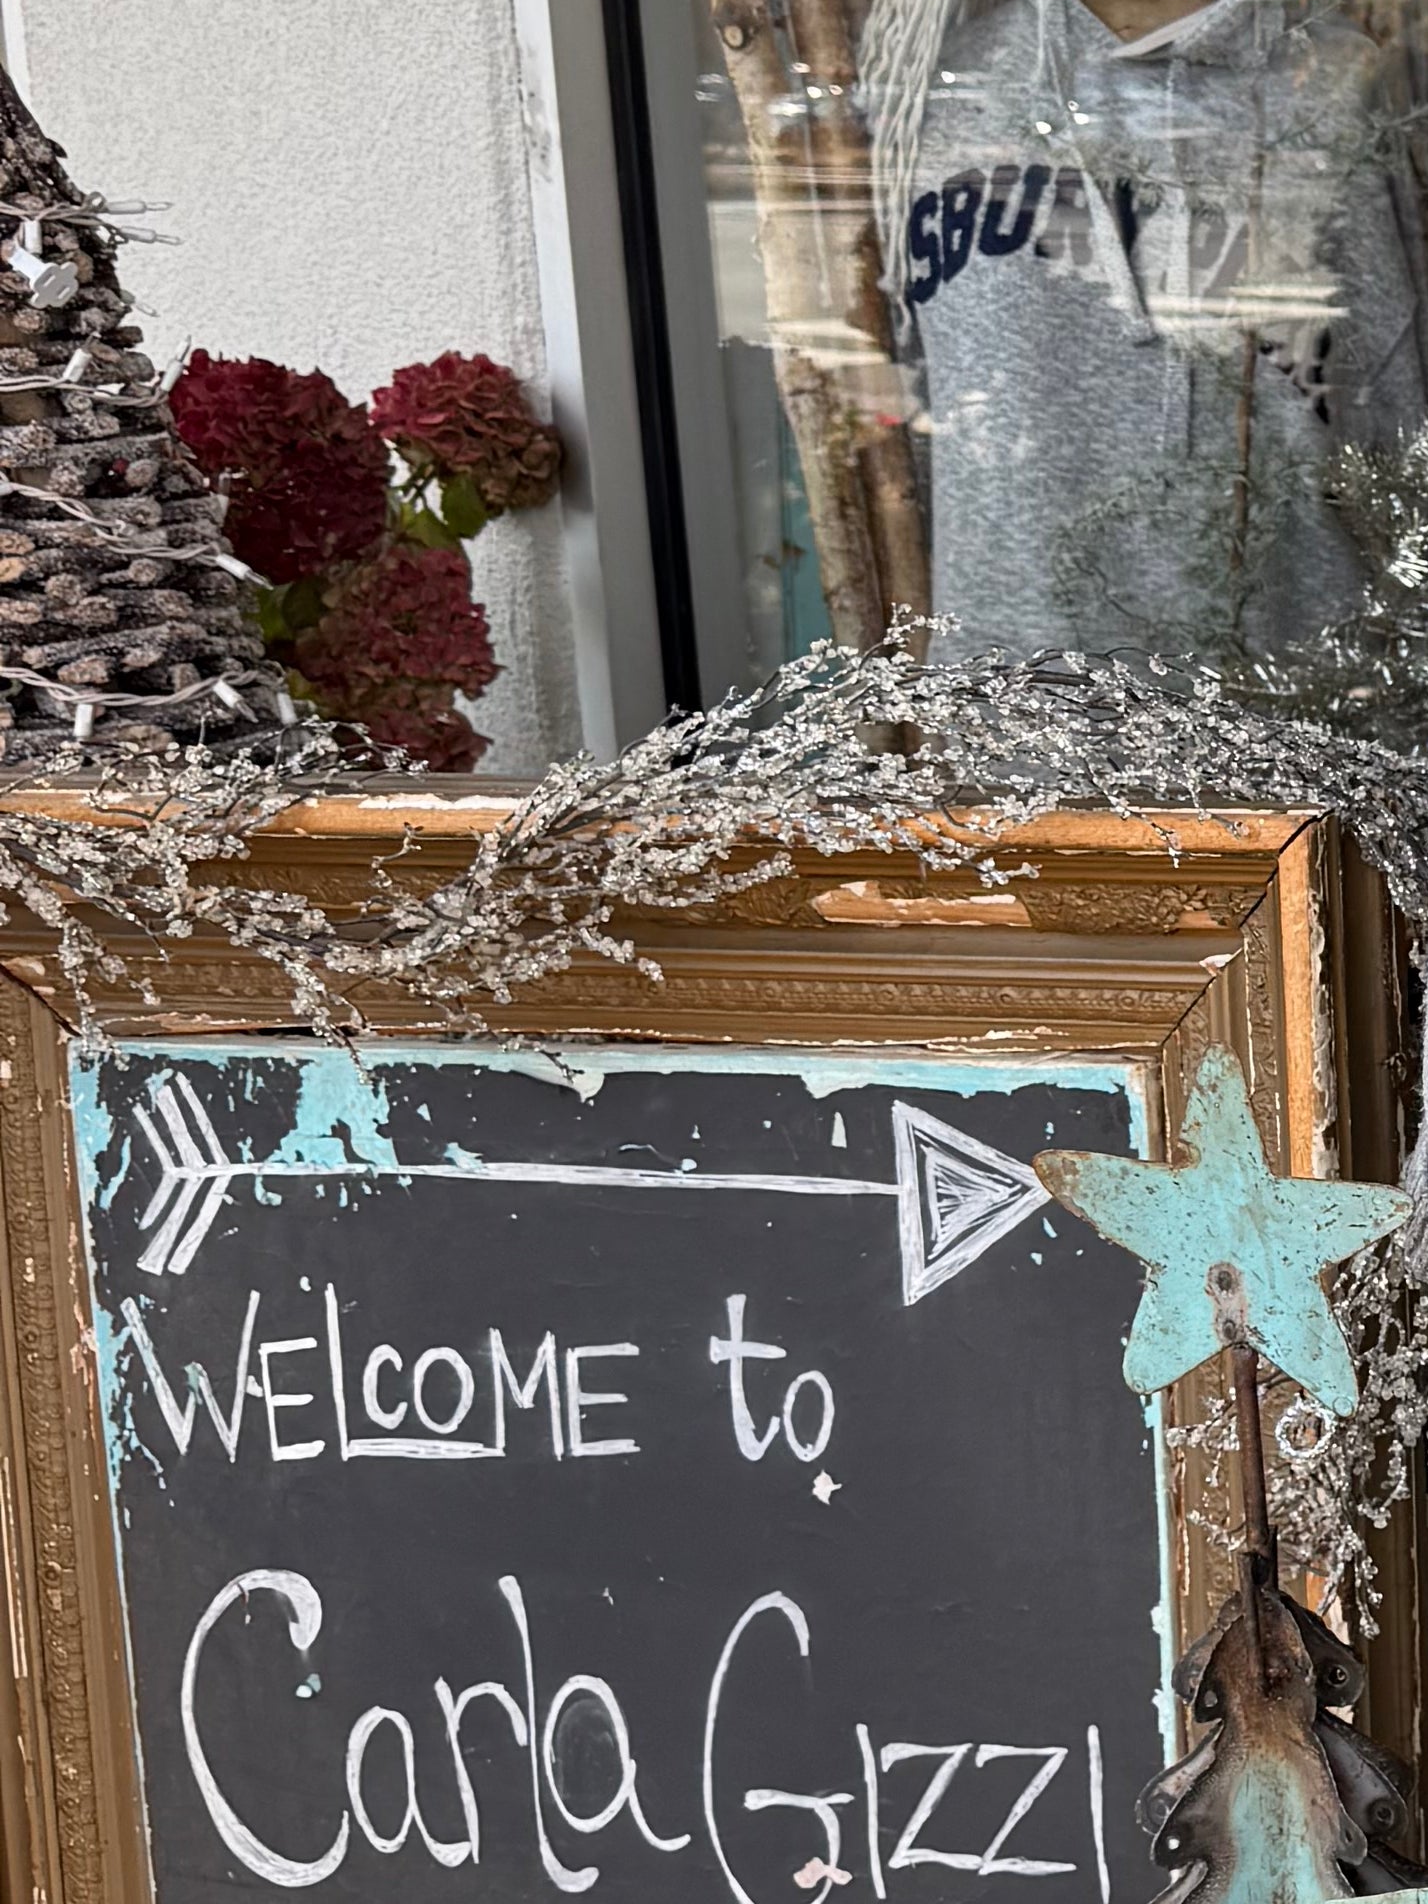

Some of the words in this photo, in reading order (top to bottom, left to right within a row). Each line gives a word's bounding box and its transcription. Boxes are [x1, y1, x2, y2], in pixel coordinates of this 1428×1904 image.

[122, 1282, 642, 1462] WELCOME
[708, 1292, 837, 1464] to
[180, 1568, 693, 1893] Carla
